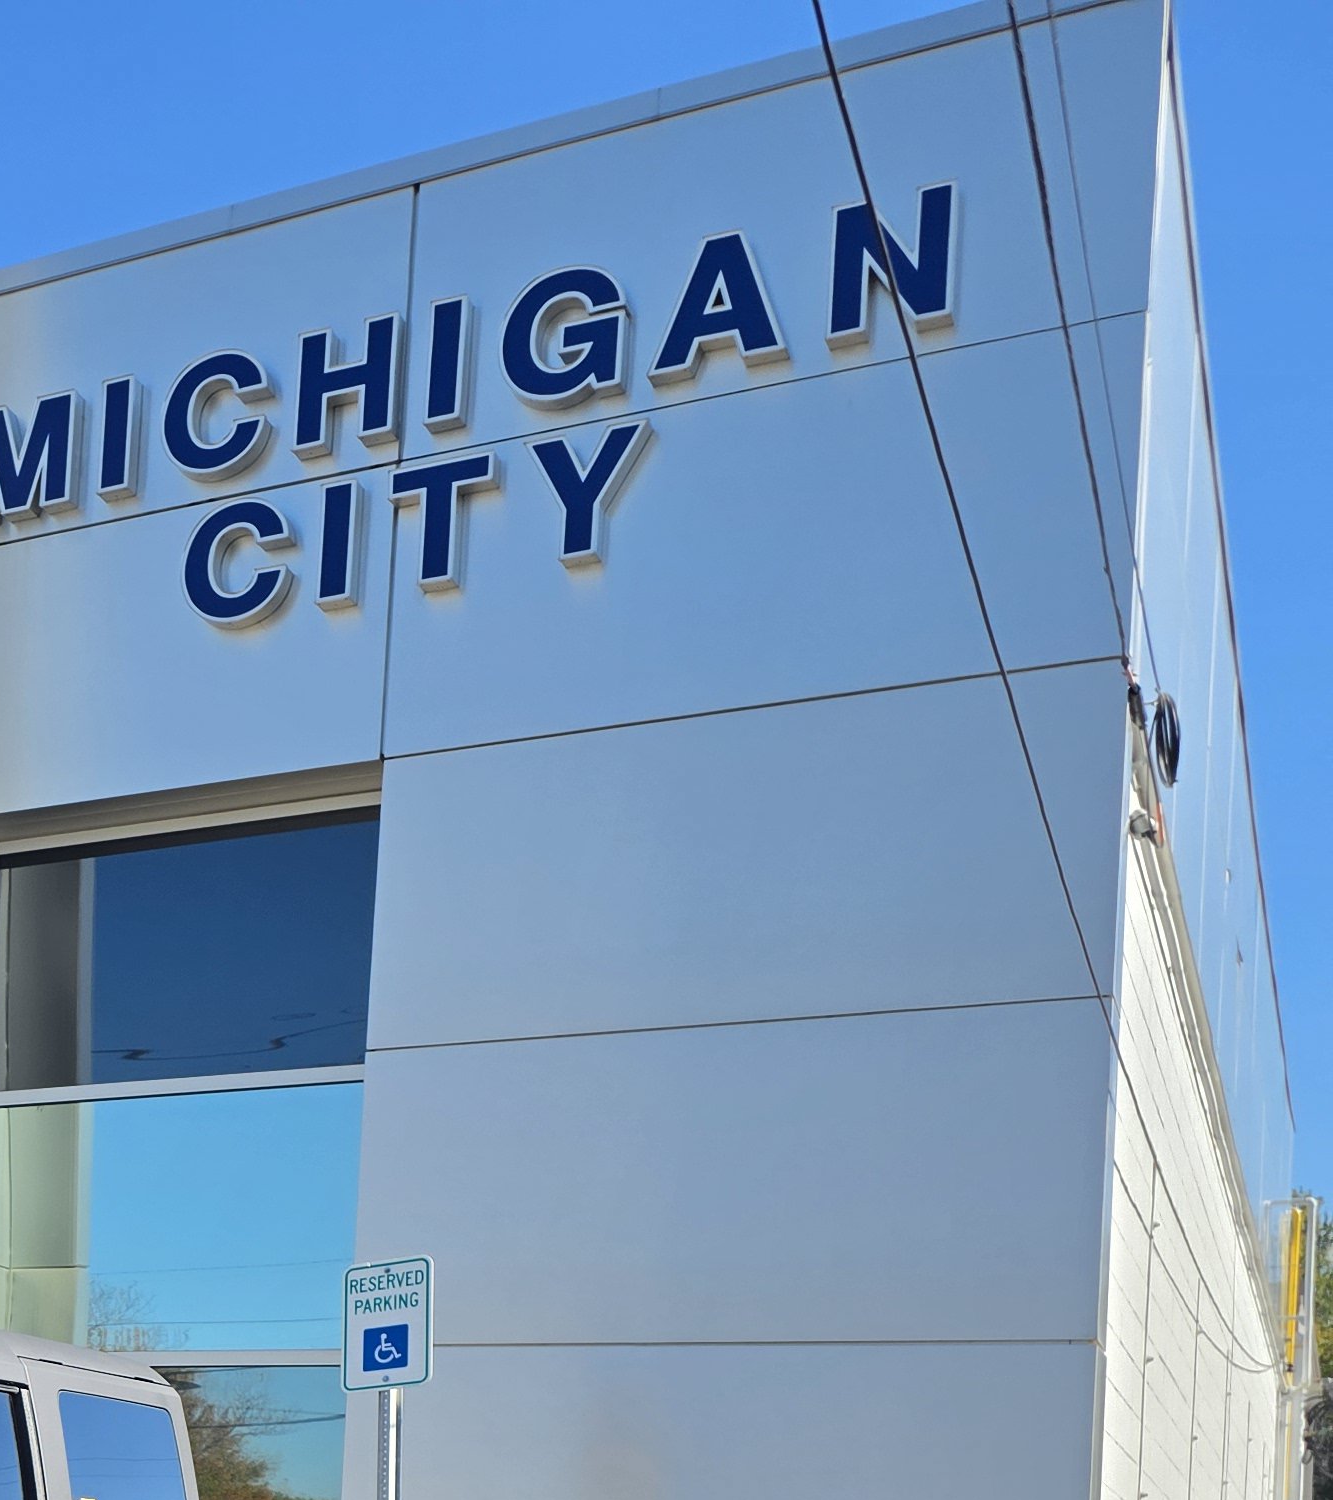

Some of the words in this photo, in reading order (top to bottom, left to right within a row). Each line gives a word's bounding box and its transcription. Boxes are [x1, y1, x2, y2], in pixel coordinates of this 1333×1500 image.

[182, 418, 652, 629] CITY
[349, 1269, 424, 1295] RESERVED
[354, 1291, 419, 1315] PARKING
